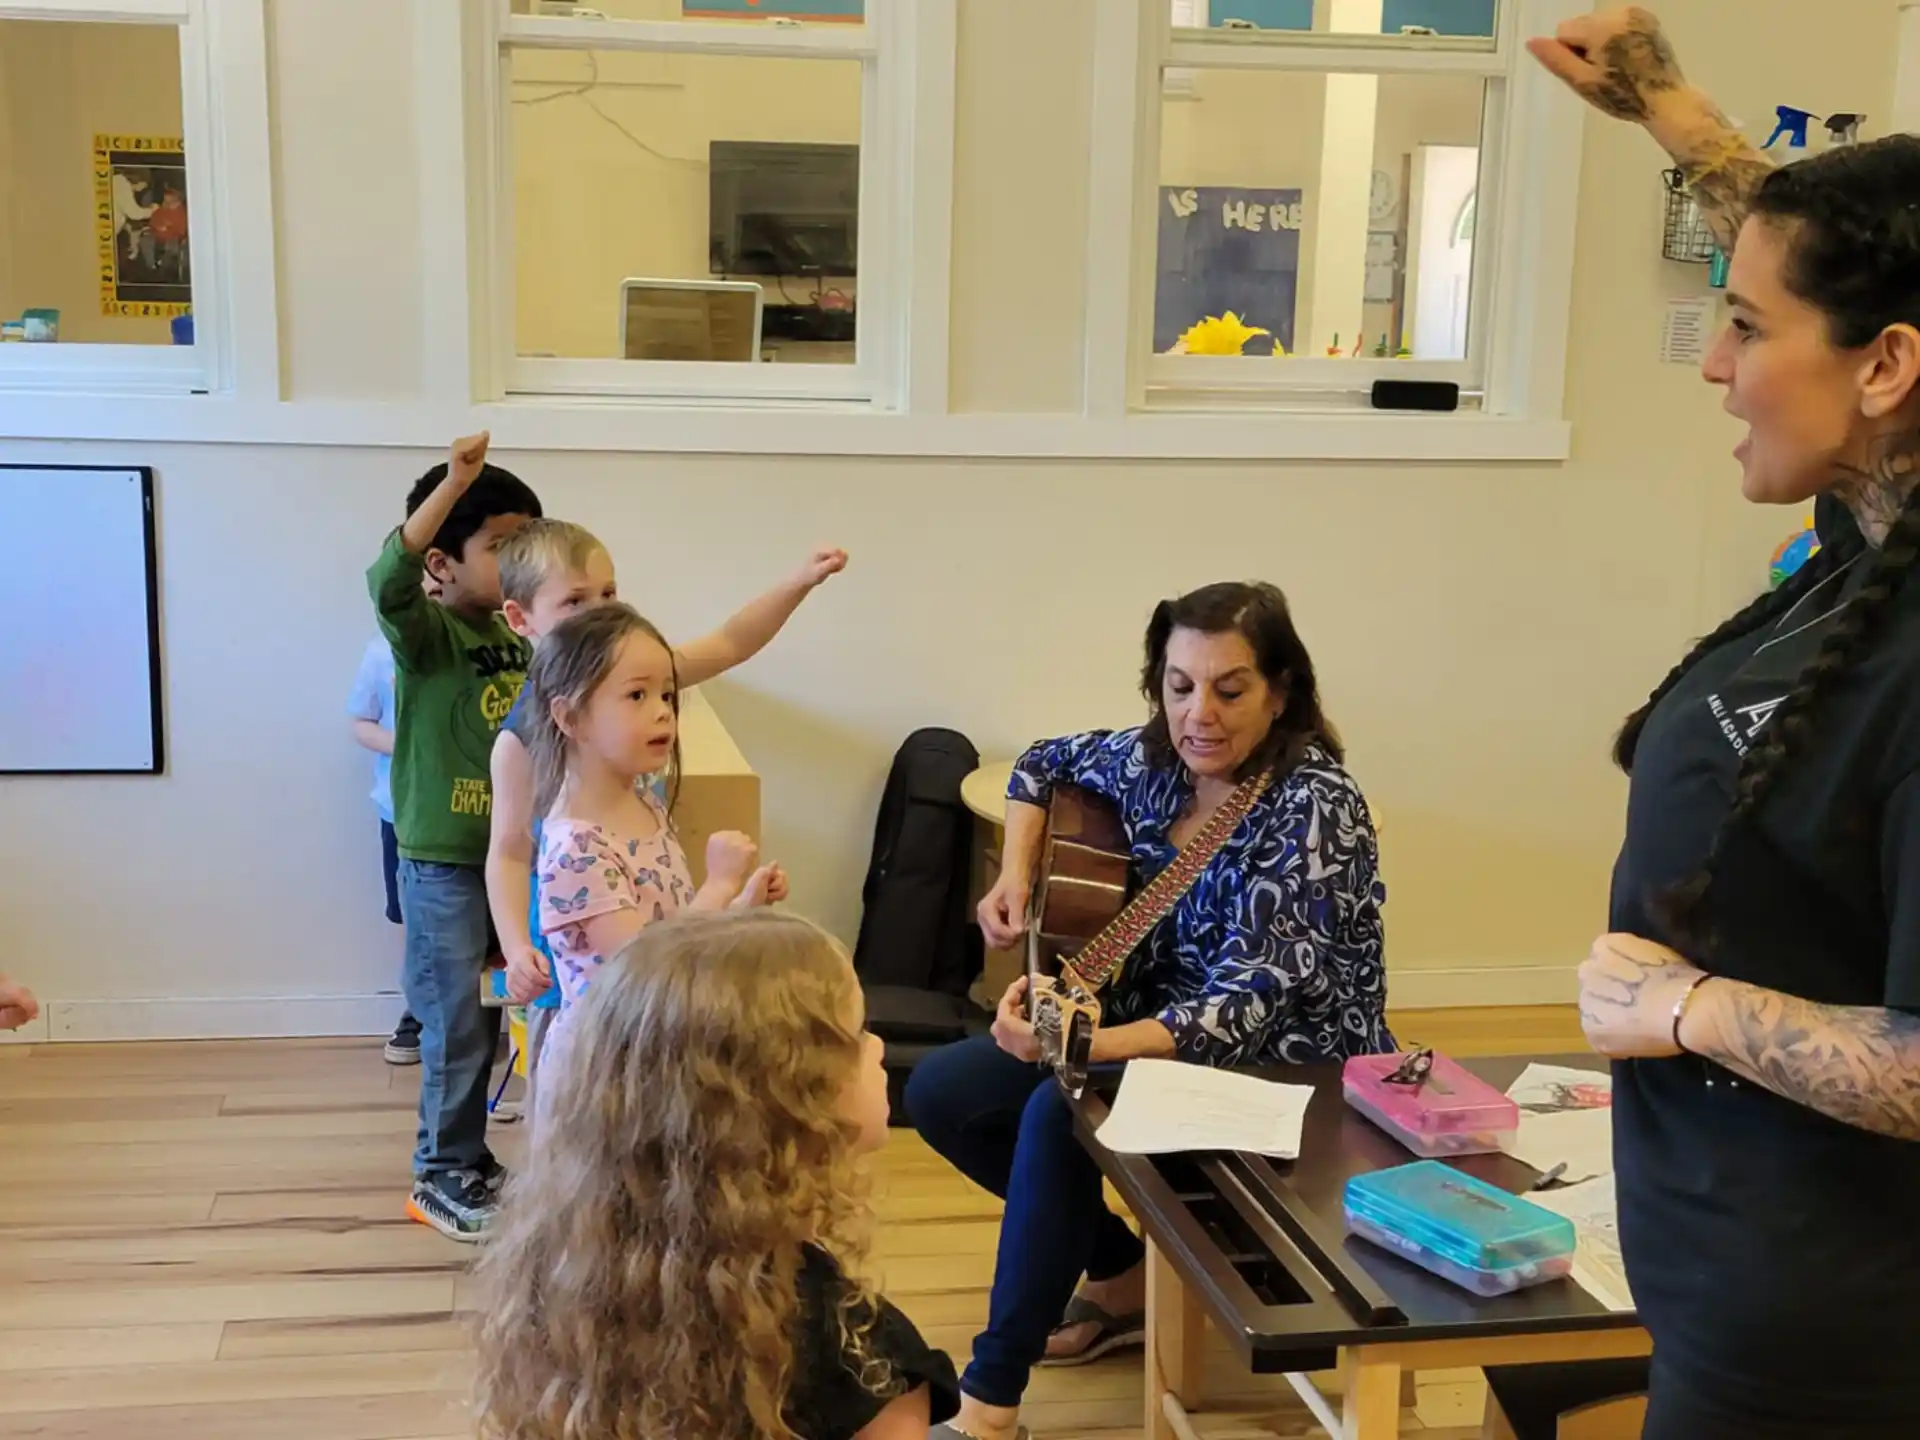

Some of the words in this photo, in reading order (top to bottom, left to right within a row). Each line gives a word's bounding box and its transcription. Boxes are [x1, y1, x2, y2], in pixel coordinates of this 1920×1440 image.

[1223, 199, 1301, 232] HERE
[1719, 717, 1748, 758] ACADE
[453, 777, 485, 792] STATE
[451, 789, 491, 816] CHAM
